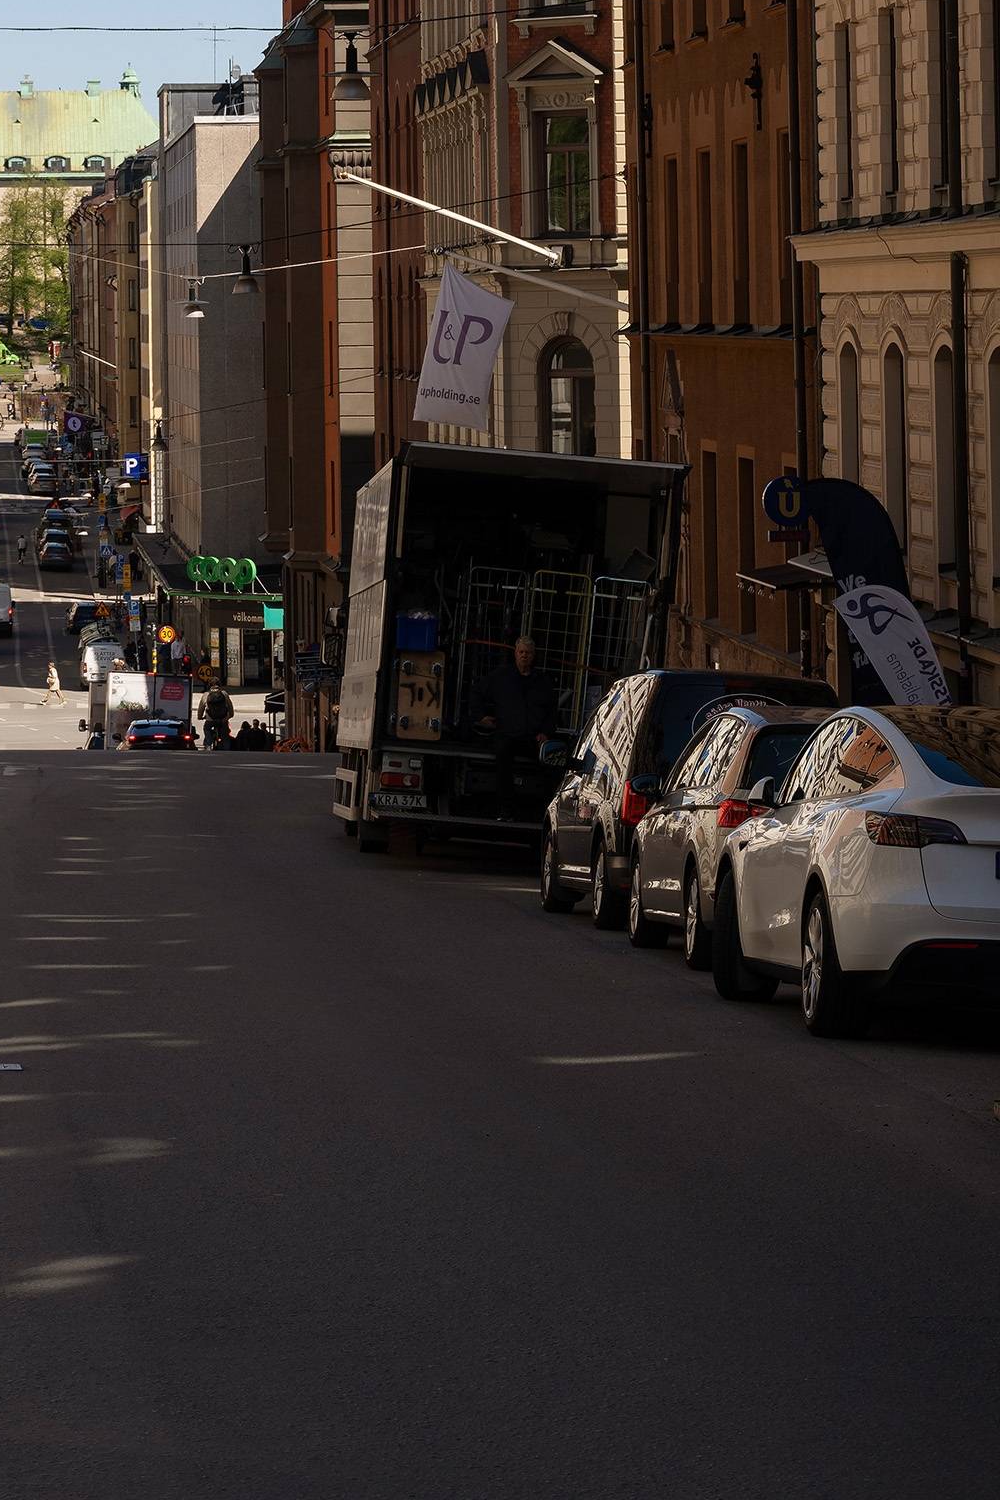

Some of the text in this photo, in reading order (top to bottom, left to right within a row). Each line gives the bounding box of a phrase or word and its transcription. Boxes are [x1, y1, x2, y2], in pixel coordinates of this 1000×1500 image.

[420, 387, 481, 405] upholding.se
[126, 457, 138, 475] P
[838, 574, 866, 593] We
[232, 612, 264, 623] välkomm
[161, 630, 173, 639] 30
[198, 667, 212, 677] 40
[377, 795, 398, 805] KRA
